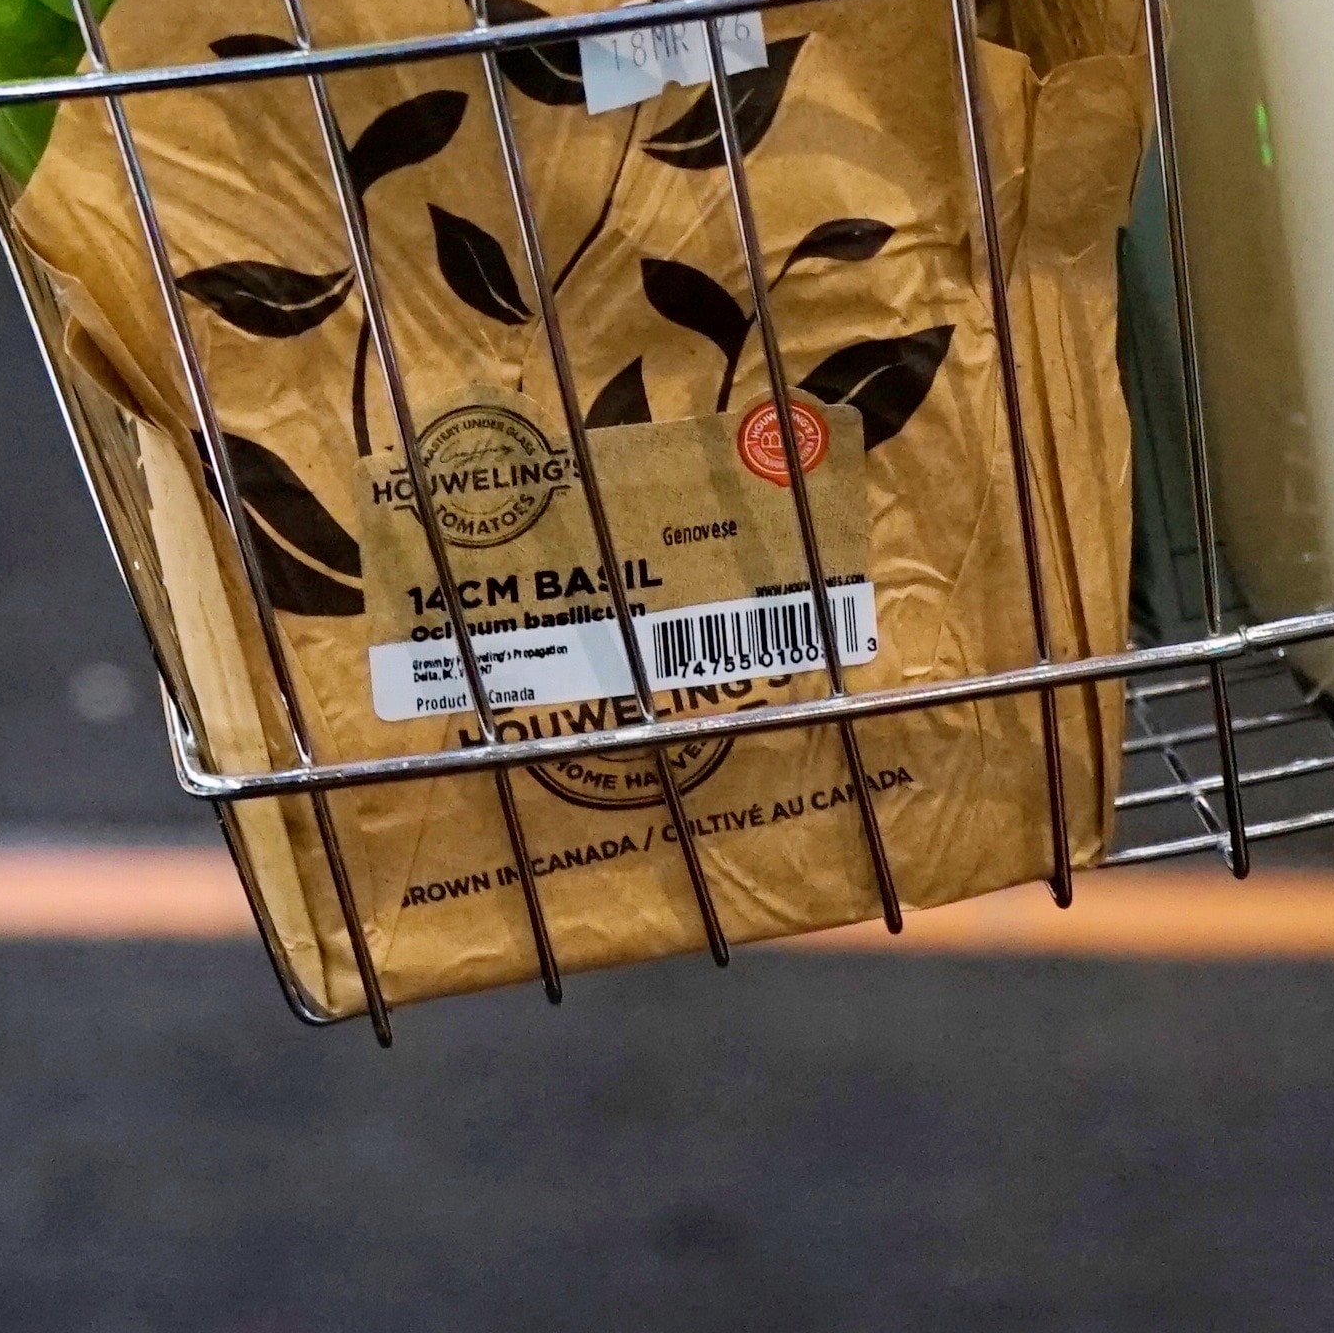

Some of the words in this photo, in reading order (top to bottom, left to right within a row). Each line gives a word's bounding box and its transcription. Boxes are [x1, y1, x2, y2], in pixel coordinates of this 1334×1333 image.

[436, 493, 535, 536] TOMATOES
[662, 519, 738, 546] Genovese
[407, 574, 519, 615] 14CM
[759, 644, 826, 668] 0100
[867, 637, 878, 652] 3
[416, 693, 467, 712] Product
[487, 687, 536, 704] Canada
[531, 835, 639, 877] CANADA
[771, 796, 805, 822] AU
